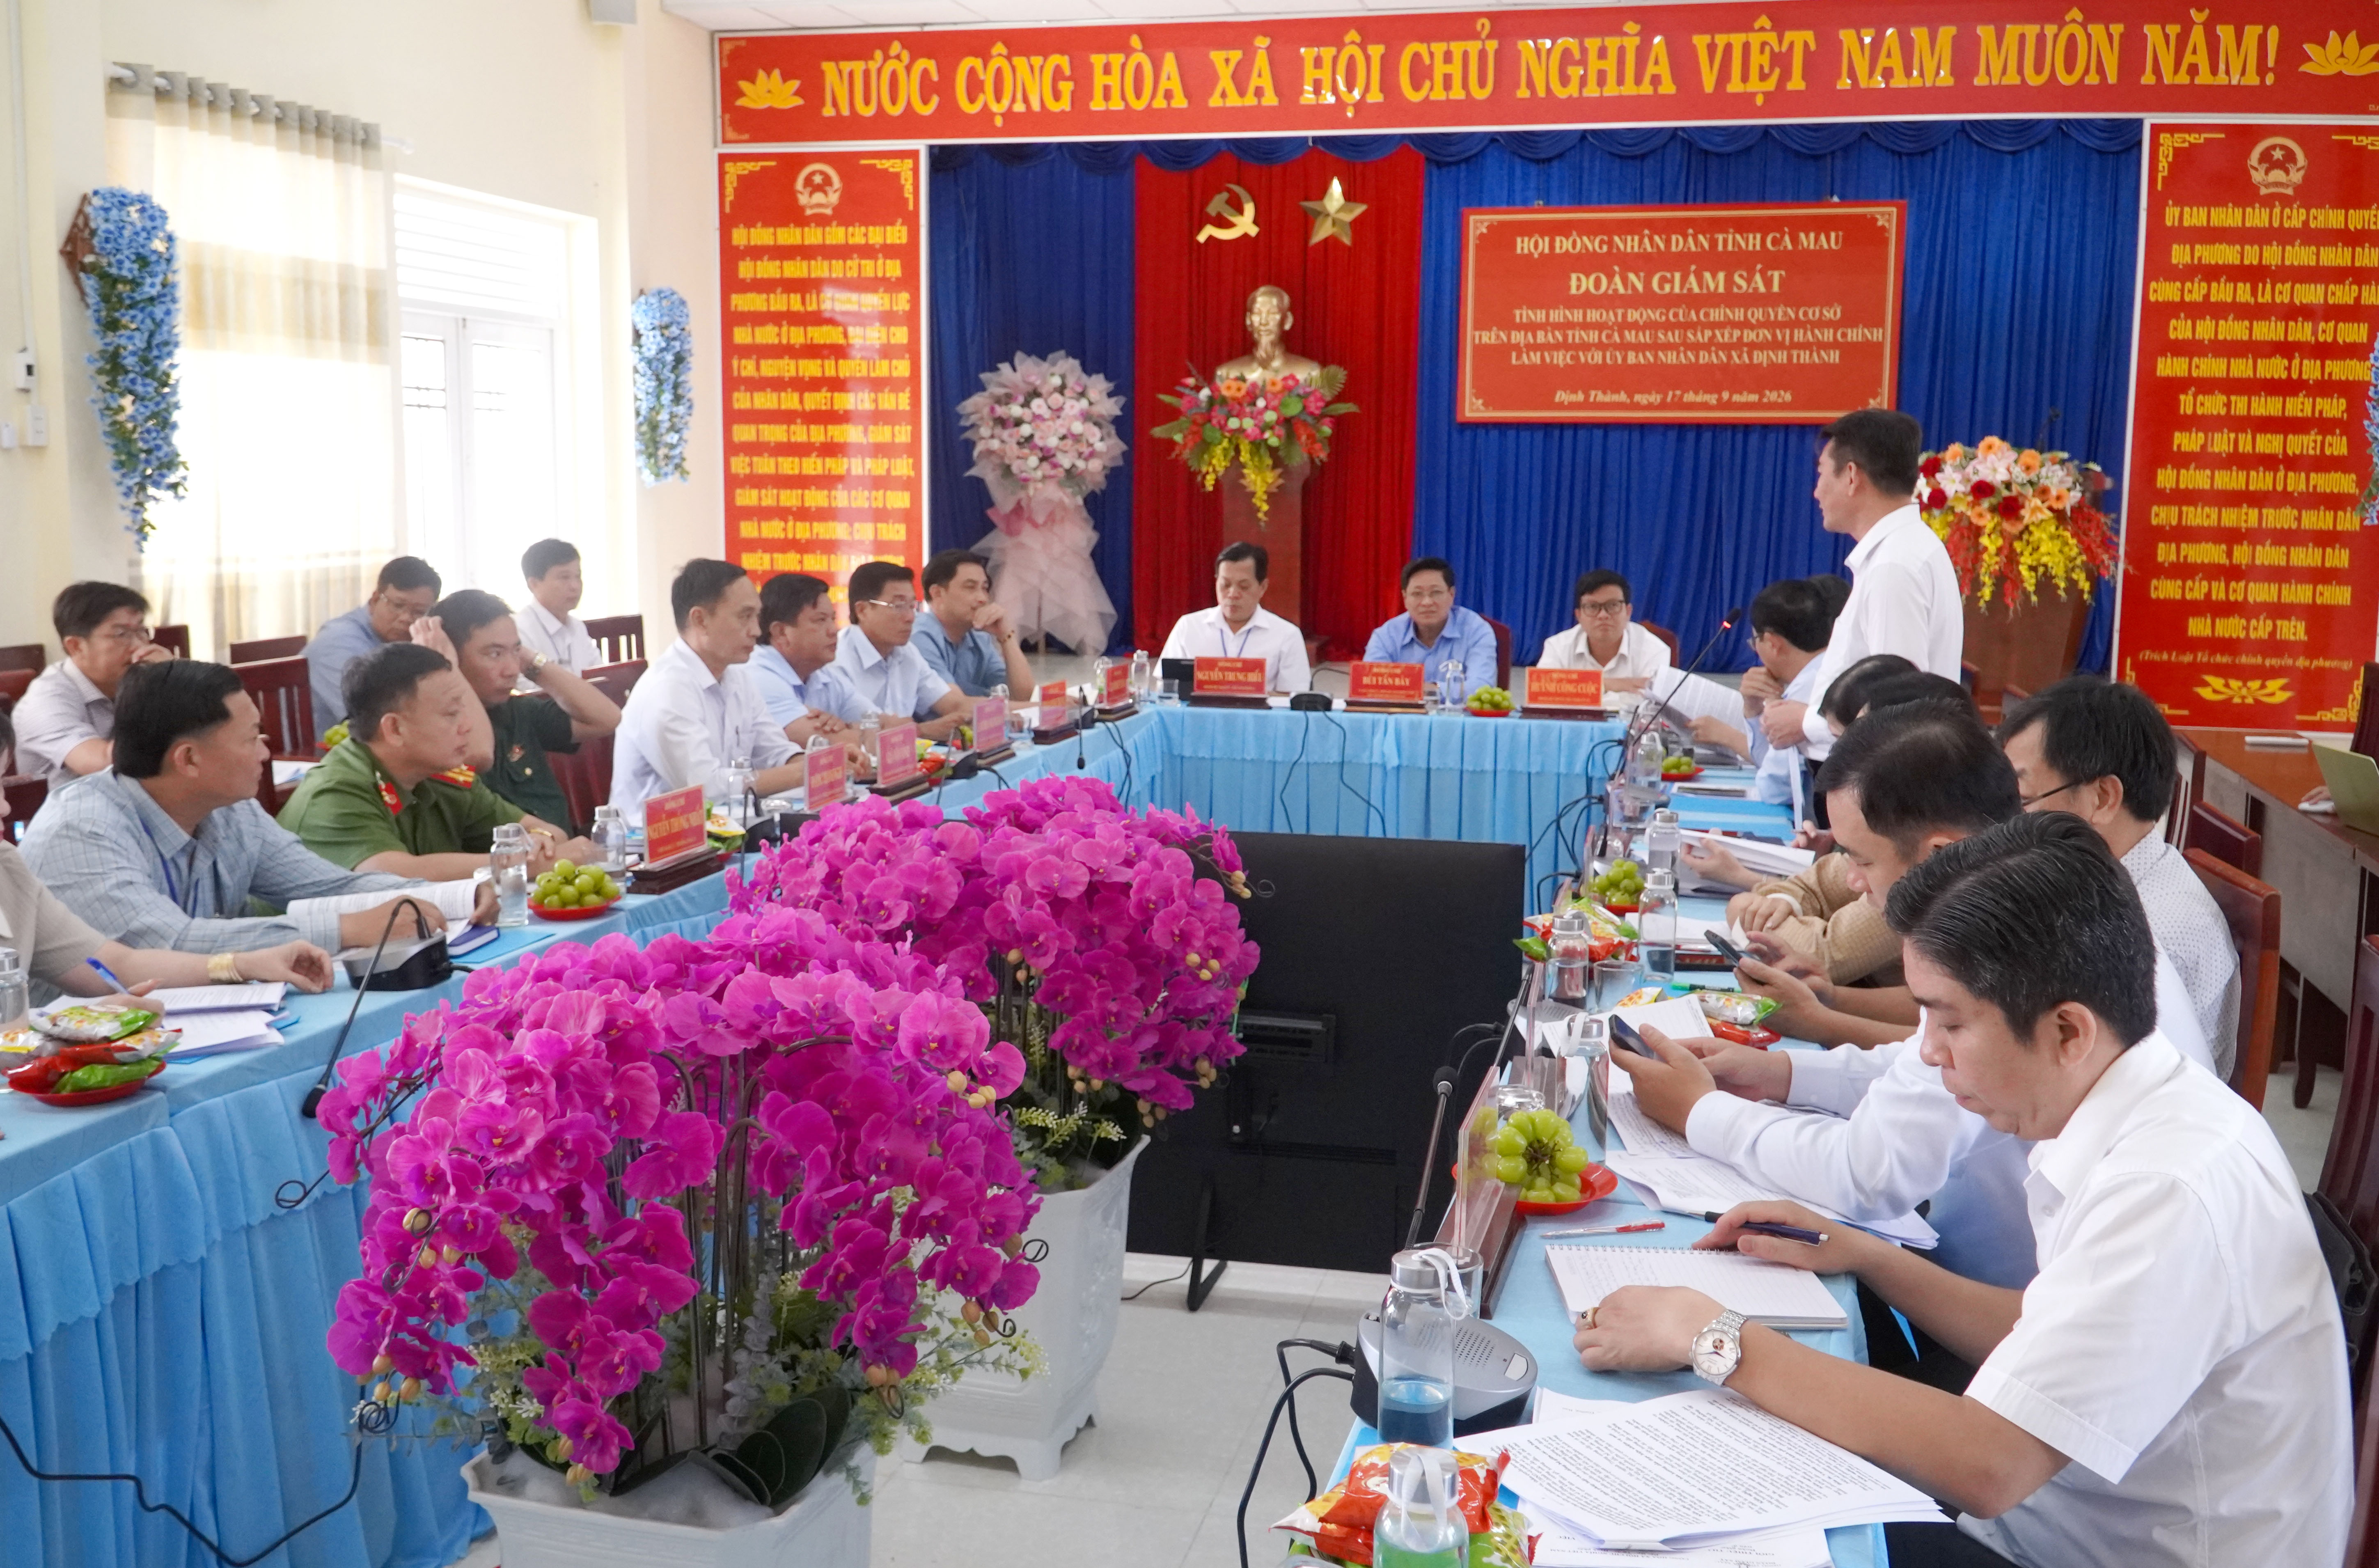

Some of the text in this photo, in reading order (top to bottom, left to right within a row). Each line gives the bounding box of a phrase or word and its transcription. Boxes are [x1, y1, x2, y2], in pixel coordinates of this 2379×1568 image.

[822, 7, 2278, 127] NƯỚC CỘNG HÒA XÃ HỘI CHỦ NGHĨA VIỆT NAM MUÔN NĂM!
[2166, 199, 2180, 226] ỦY
[2183, 206, 2207, 227] BAN
[2210, 203, 2242, 227] NHÂN
[2245, 203, 2269, 227] DÂN
[2272, 201, 2280, 227] Ở
[2283, 202, 2306, 228] CẤP
[2310, 205, 2345, 228] CHÍNH
[1516, 227, 1842, 258] HỘI ĐỒNG NHÂN DÂN TỈNH CÀ MAU
[2171, 240, 2379, 269] ĐỊA PHƯƠNG DO HỘI ĐỒNG NHÂN DÂN
[1570, 264, 1785, 294] ĐOÀN GIÁM SÁT
[2149, 275, 2379, 305] CÙNG CẤP BẦU RA, LÀ CƠ QUAN CHẤP HÀ
[1513, 304, 1841, 325] TÌNH HÌNH HOẠT ĐỘNG CỦA CHÍNH QUYỀN CƠ SỞ
[1474, 326, 1508, 344] TRÊN
[1510, 330, 1534, 347] ĐỊA
[1536, 326, 1563, 344] BÀN
[1566, 327, 1598, 343] TỈNH
[1602, 325, 1620, 343] CÀ
[1624, 328, 1654, 343] MAU
[1657, 329, 1683, 343] SAU
[1776, 328, 1790, 345] VỊ
[1794, 325, 1834, 342] HÀNH
[1837, 325, 1883, 342] CHÍNH
[1512, 346, 1839, 367] LÀM VIỆC VỚI ỦY BAN NHÂN DÂN XÃ ĐỊNH THÀNH
[2157, 353, 2372, 383] HÀNH CHÍNH NHÀ NƯỚC Ở ĐỊA PHƯƠNG
[2180, 388, 2347, 420] TỔ CHỨC THI HÀNH HIẾN PHÁP,
[2157, 463, 2359, 495] HỘI ĐỒNG NHÂN DÂN Ở ĐỊA PHƯƠNG,
[2151, 503, 2360, 531] CHỊU TRÁCH NHIỆM TRƯỚC NHÂN DÂN
[2151, 573, 2351, 605] CÙNG CẤP VÀ CƠ QUAN HÀNH CHÍNH
[2188, 613, 2307, 641] NHÀ NƯỚC CẤP TRÊN.
